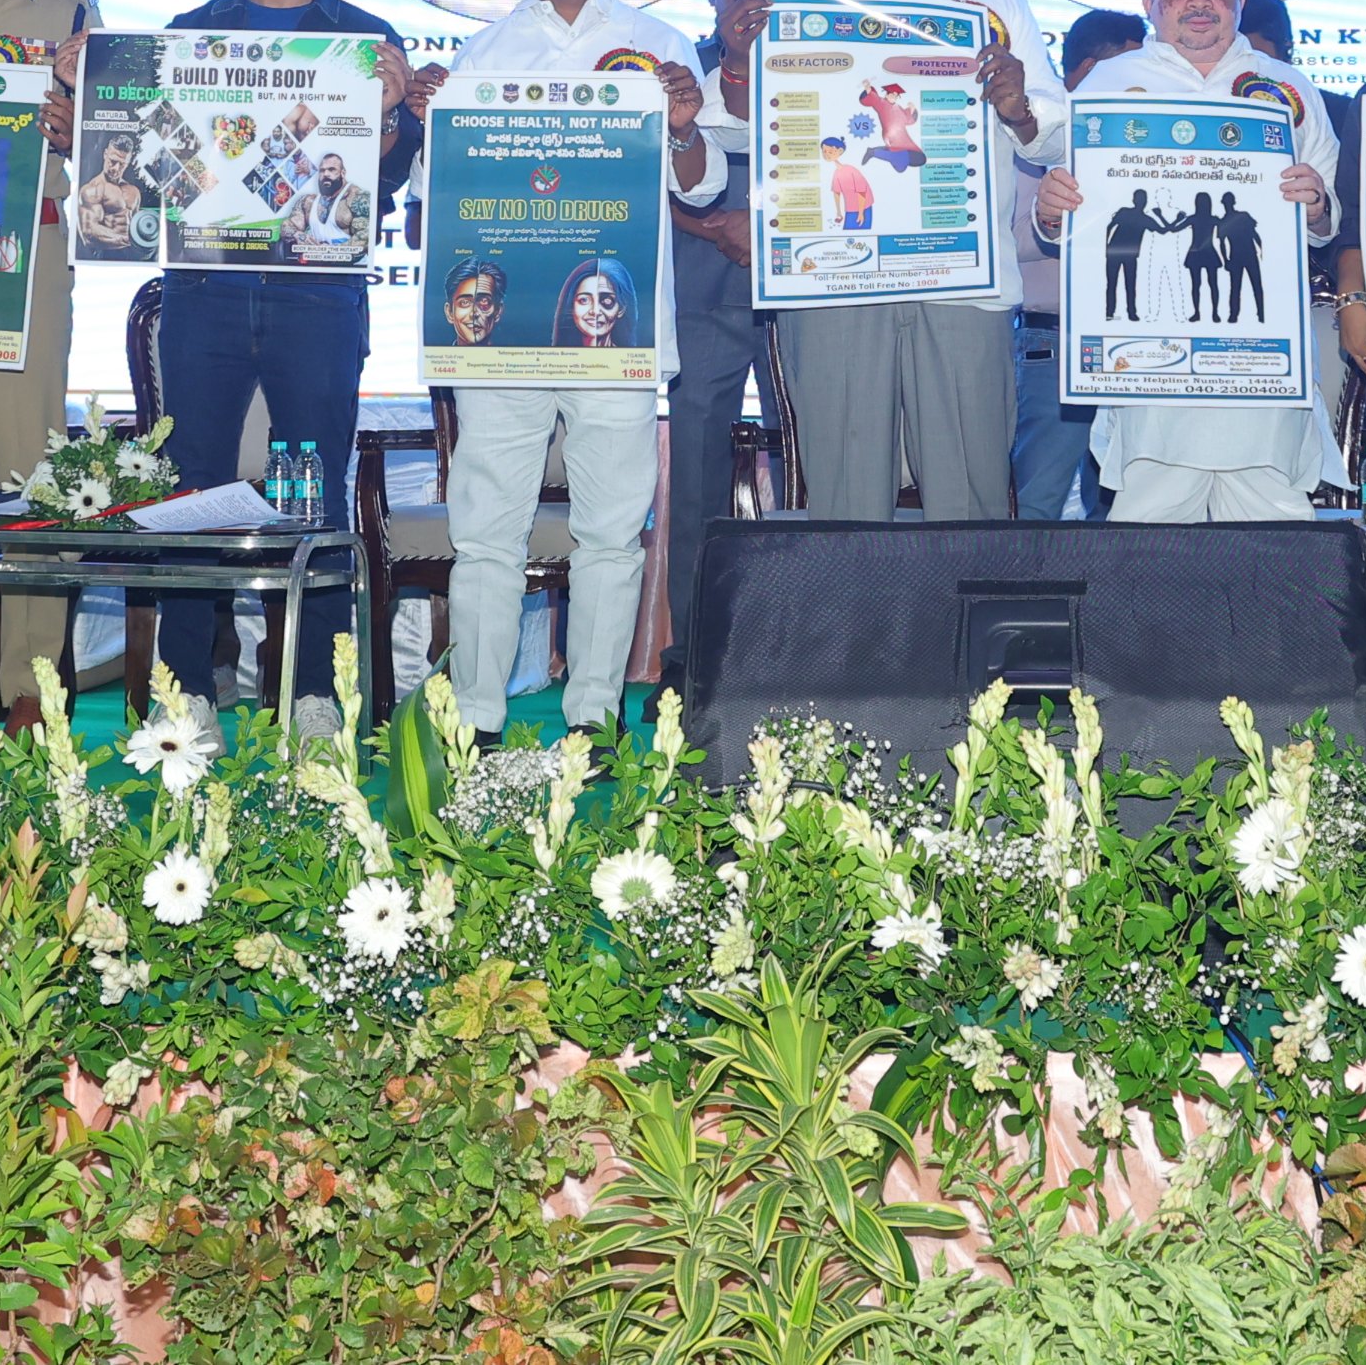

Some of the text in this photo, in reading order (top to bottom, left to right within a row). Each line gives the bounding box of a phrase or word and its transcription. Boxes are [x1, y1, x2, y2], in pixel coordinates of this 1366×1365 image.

[771, 58, 849, 67] RISK FACTORS
[912, 60, 968, 68] PROTECTIVE
[173, 67, 317, 89] BUILD YOUR BODY
[96, 85, 253, 104] TO BECOME STRONGER
[258, 93, 347, 102] BUT, IN A RIGHT WAY
[96, 111, 128, 120] NATURAL
[327, 117, 365, 126] ARTIFICIAL
[452, 116, 643, 130] CHOOSE HEALTH, NOT HARM
[854, 121, 869, 131] VS
[318, 128, 372, 137] BODY BUILDING
[1121, 154, 1143, 164] మీరు
[1107, 168, 1129, 178] మీరు
[459, 199, 628, 222] SAY NO TO DRUGS
[813, 271, 886, 281] Toll-Free Helpline
[622, 369, 652, 378] 1908
[1143, 376, 1189, 385] Helpline
[1075, 385, 1297, 394] Help Desk 040-23004002
